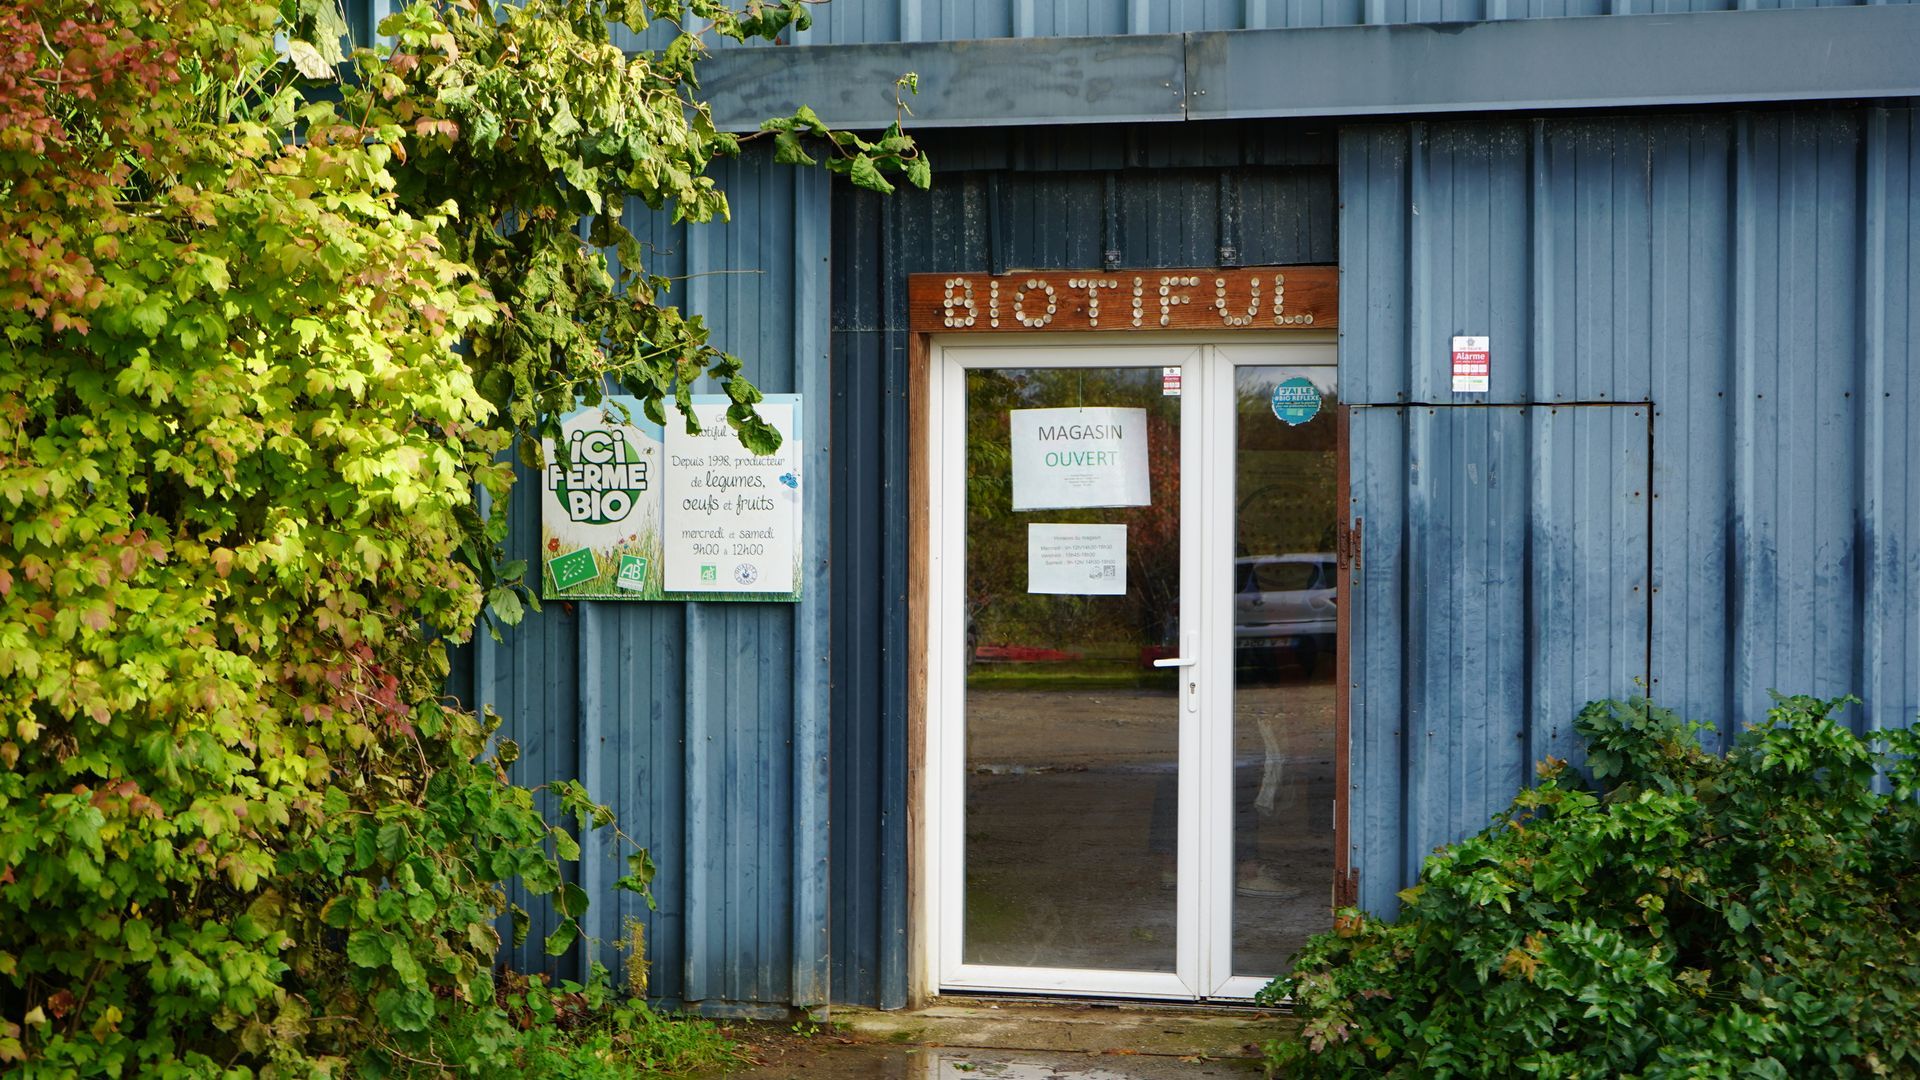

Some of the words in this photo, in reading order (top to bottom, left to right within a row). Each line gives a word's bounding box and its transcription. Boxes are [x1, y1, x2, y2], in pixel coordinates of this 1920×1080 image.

[944, 273, 1314, 328] BIOTIFUL
[1456, 353, 1486, 361] Alarme
[1280, 387, 1298, 395] J'AI
[1300, 387, 1313, 395] LE
[690, 424, 727, 440] otiful
[1038, 425, 1122, 441] MAGASIN
[672, 456, 704, 468] Depuis
[735, 457, 785, 469] producteur
[1045, 451, 1118, 467] OUVERT
[549, 462, 647, 492] FERME
[691, 476, 703, 487] de
[567, 489, 632, 522] BIO
[682, 494, 719, 515] oeufs
[724, 500, 733, 511] et
[736, 494, 774, 515] fruits
[682, 527, 724, 539] mercredi
[740, 527, 774, 539] samedi
[693, 543, 719, 556] 9h00
[733, 543, 764, 556] 12h00
[621, 564, 641, 580] AB
